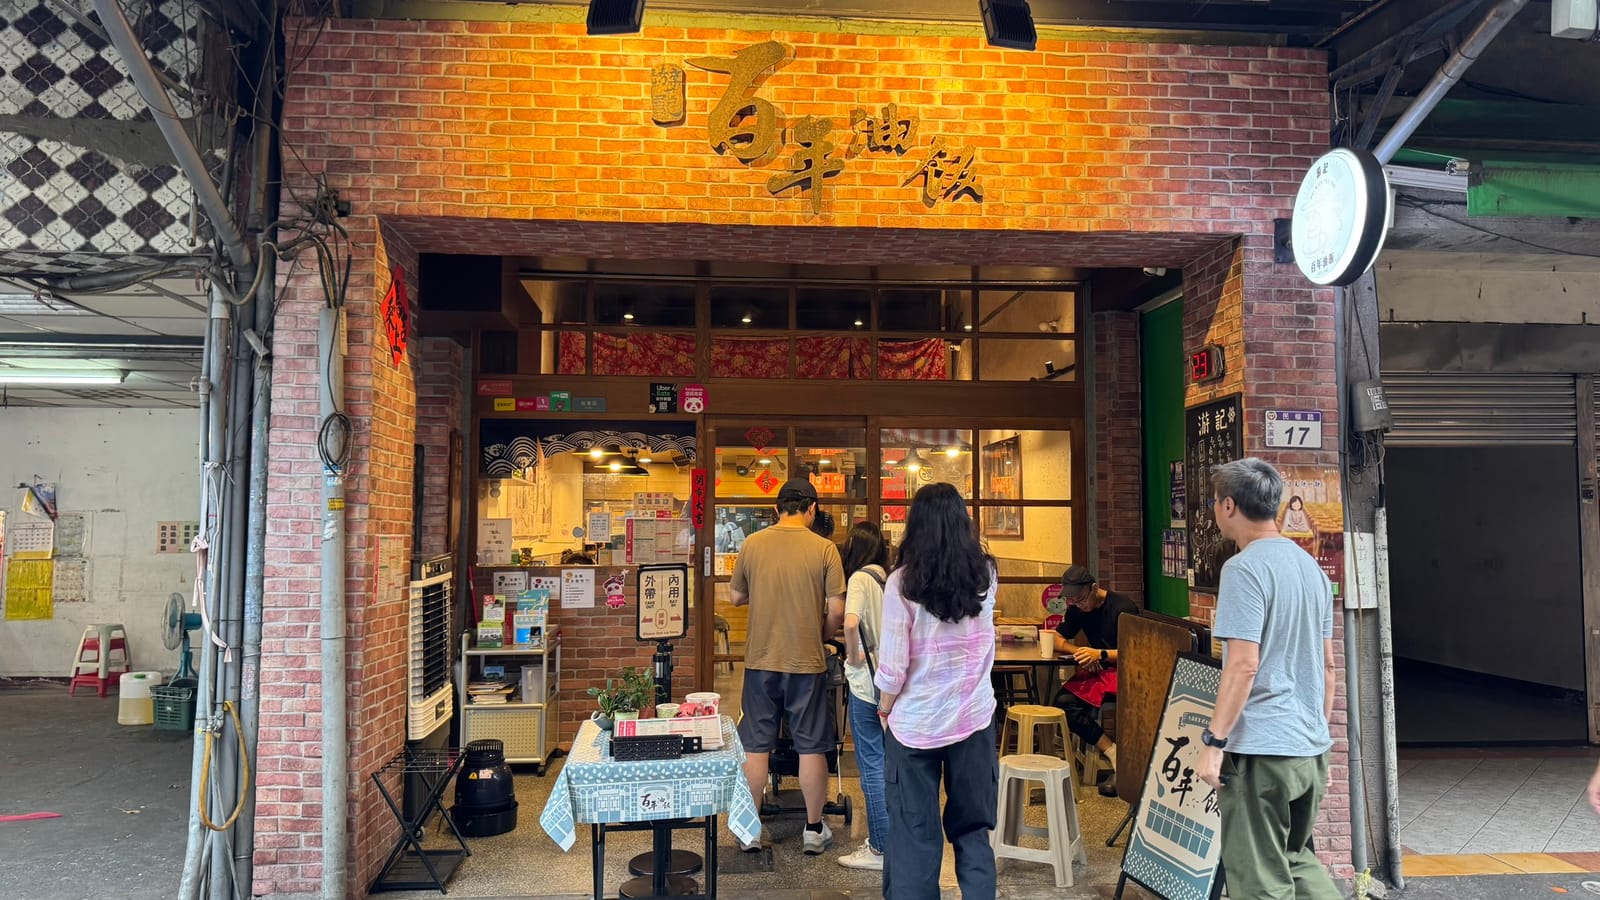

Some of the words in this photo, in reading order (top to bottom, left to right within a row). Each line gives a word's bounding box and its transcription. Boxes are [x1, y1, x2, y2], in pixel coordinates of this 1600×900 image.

[684, 40, 984, 215] 百年油飯
[1192, 351, 1208, 380] 23
[1197, 408, 1228, 436] 游記
[1284, 426, 1311, 446] 17
[644, 575, 657, 600] 外帶
[668, 574, 680, 599] 內用
